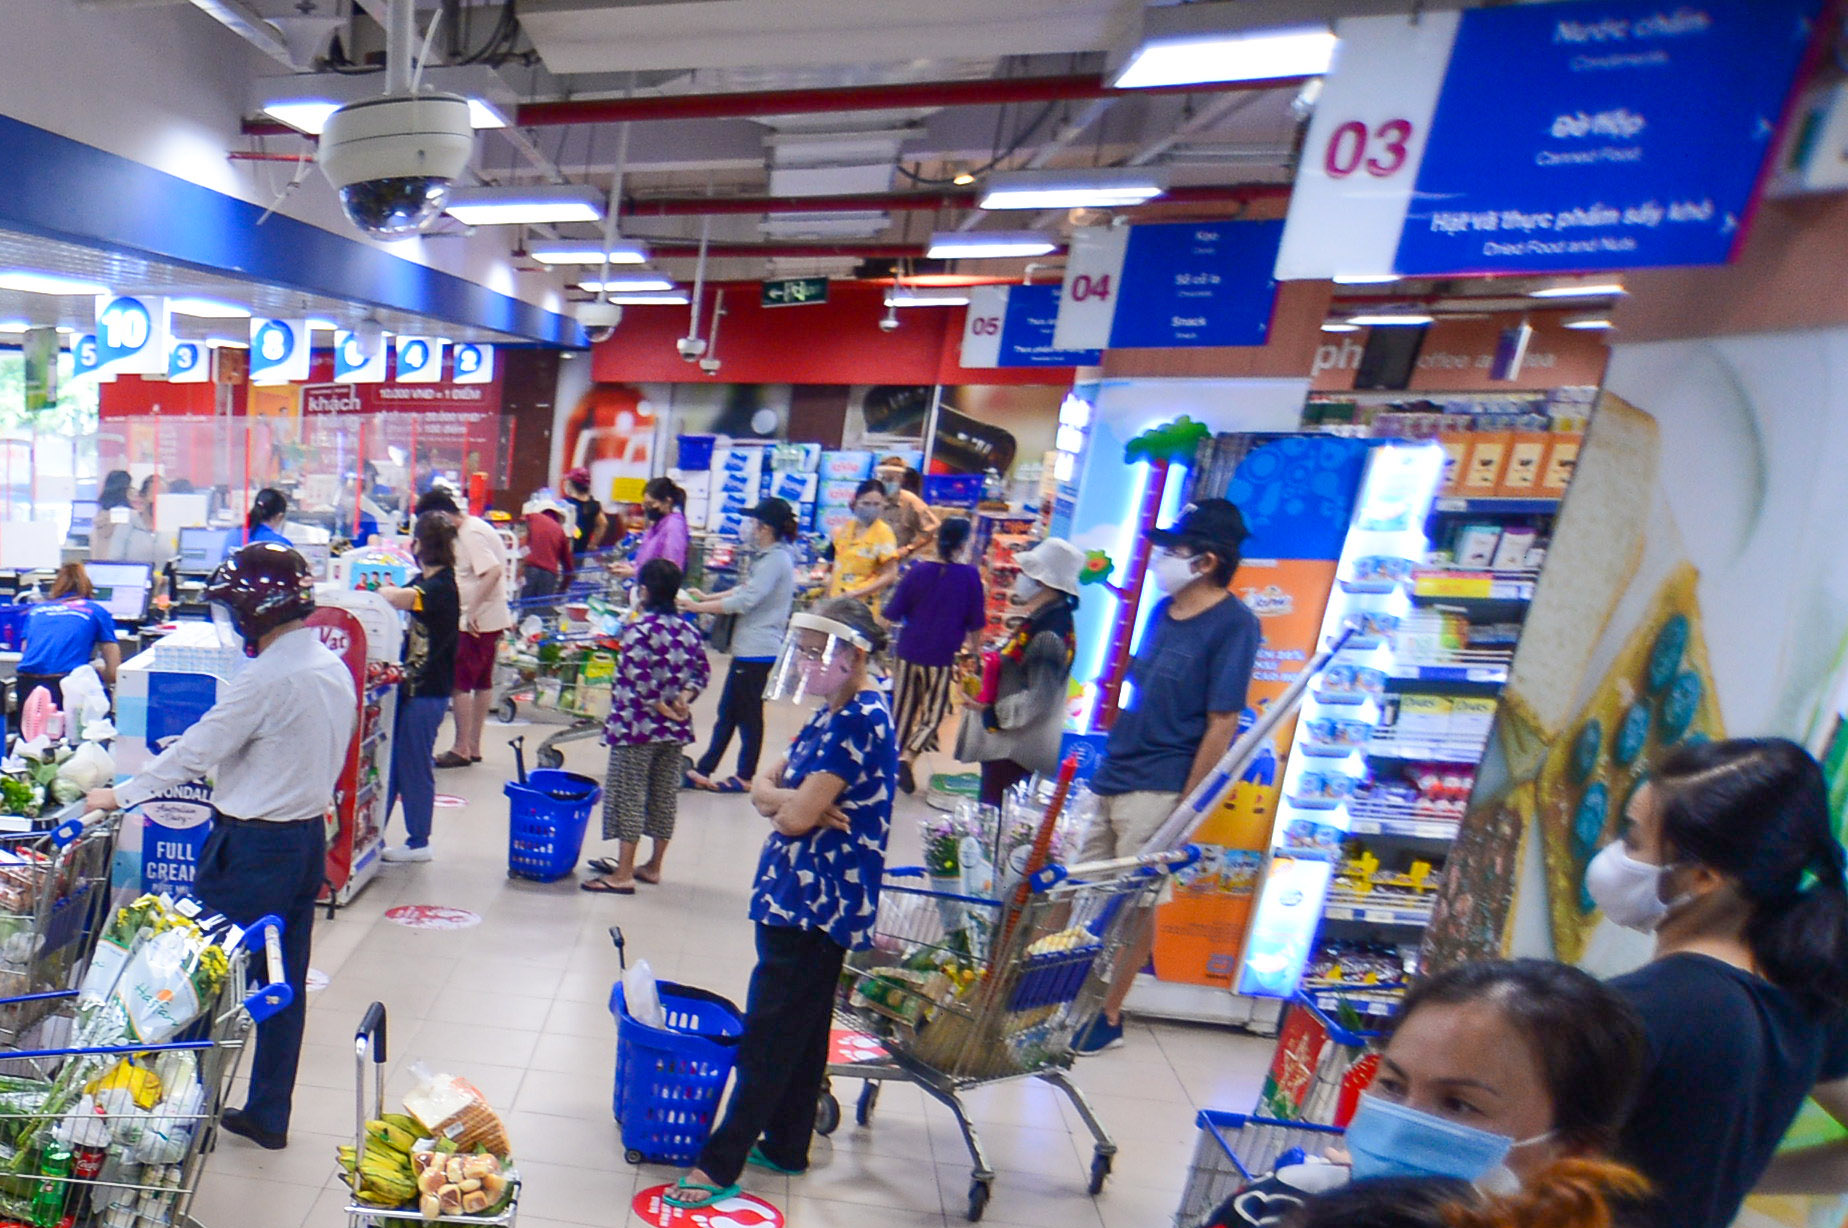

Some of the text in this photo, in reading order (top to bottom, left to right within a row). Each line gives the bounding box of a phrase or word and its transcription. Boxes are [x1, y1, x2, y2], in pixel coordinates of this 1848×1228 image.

[1323, 118, 1414, 180] 03
[1071, 273, 1111, 302] 04
[101, 305, 148, 350] 10
[972, 316, 999, 336] 05
[80, 335, 97, 364] 5
[262, 325, 287, 361] 8
[404, 344, 424, 369] 4
[178, 345, 195, 369] 3
[459, 348, 478, 372] 2
[156, 841, 196, 861] FULL
